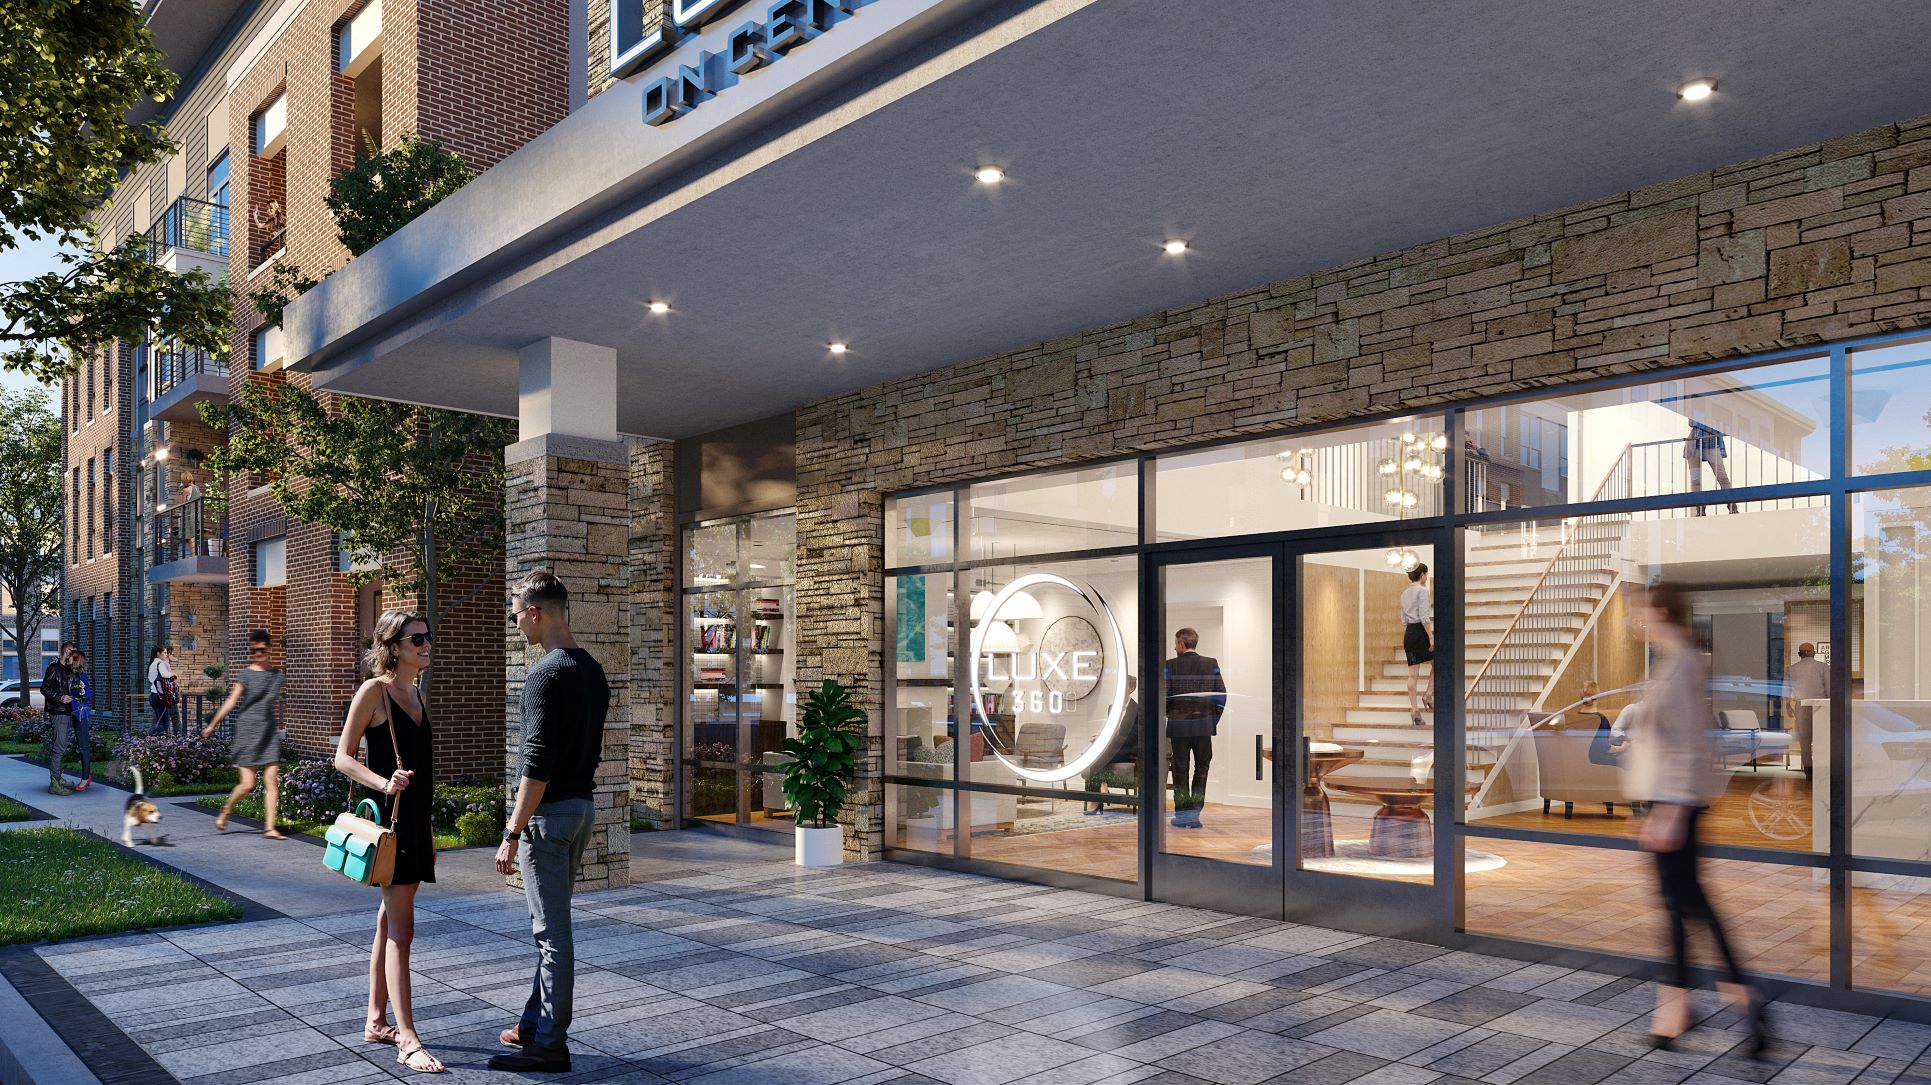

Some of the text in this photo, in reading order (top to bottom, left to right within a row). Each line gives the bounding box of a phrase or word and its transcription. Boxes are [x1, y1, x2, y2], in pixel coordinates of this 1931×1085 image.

[641, 50, 706, 125] ON
[988, 650, 1098, 681] LUXE
[1012, 690, 1064, 714] 360
